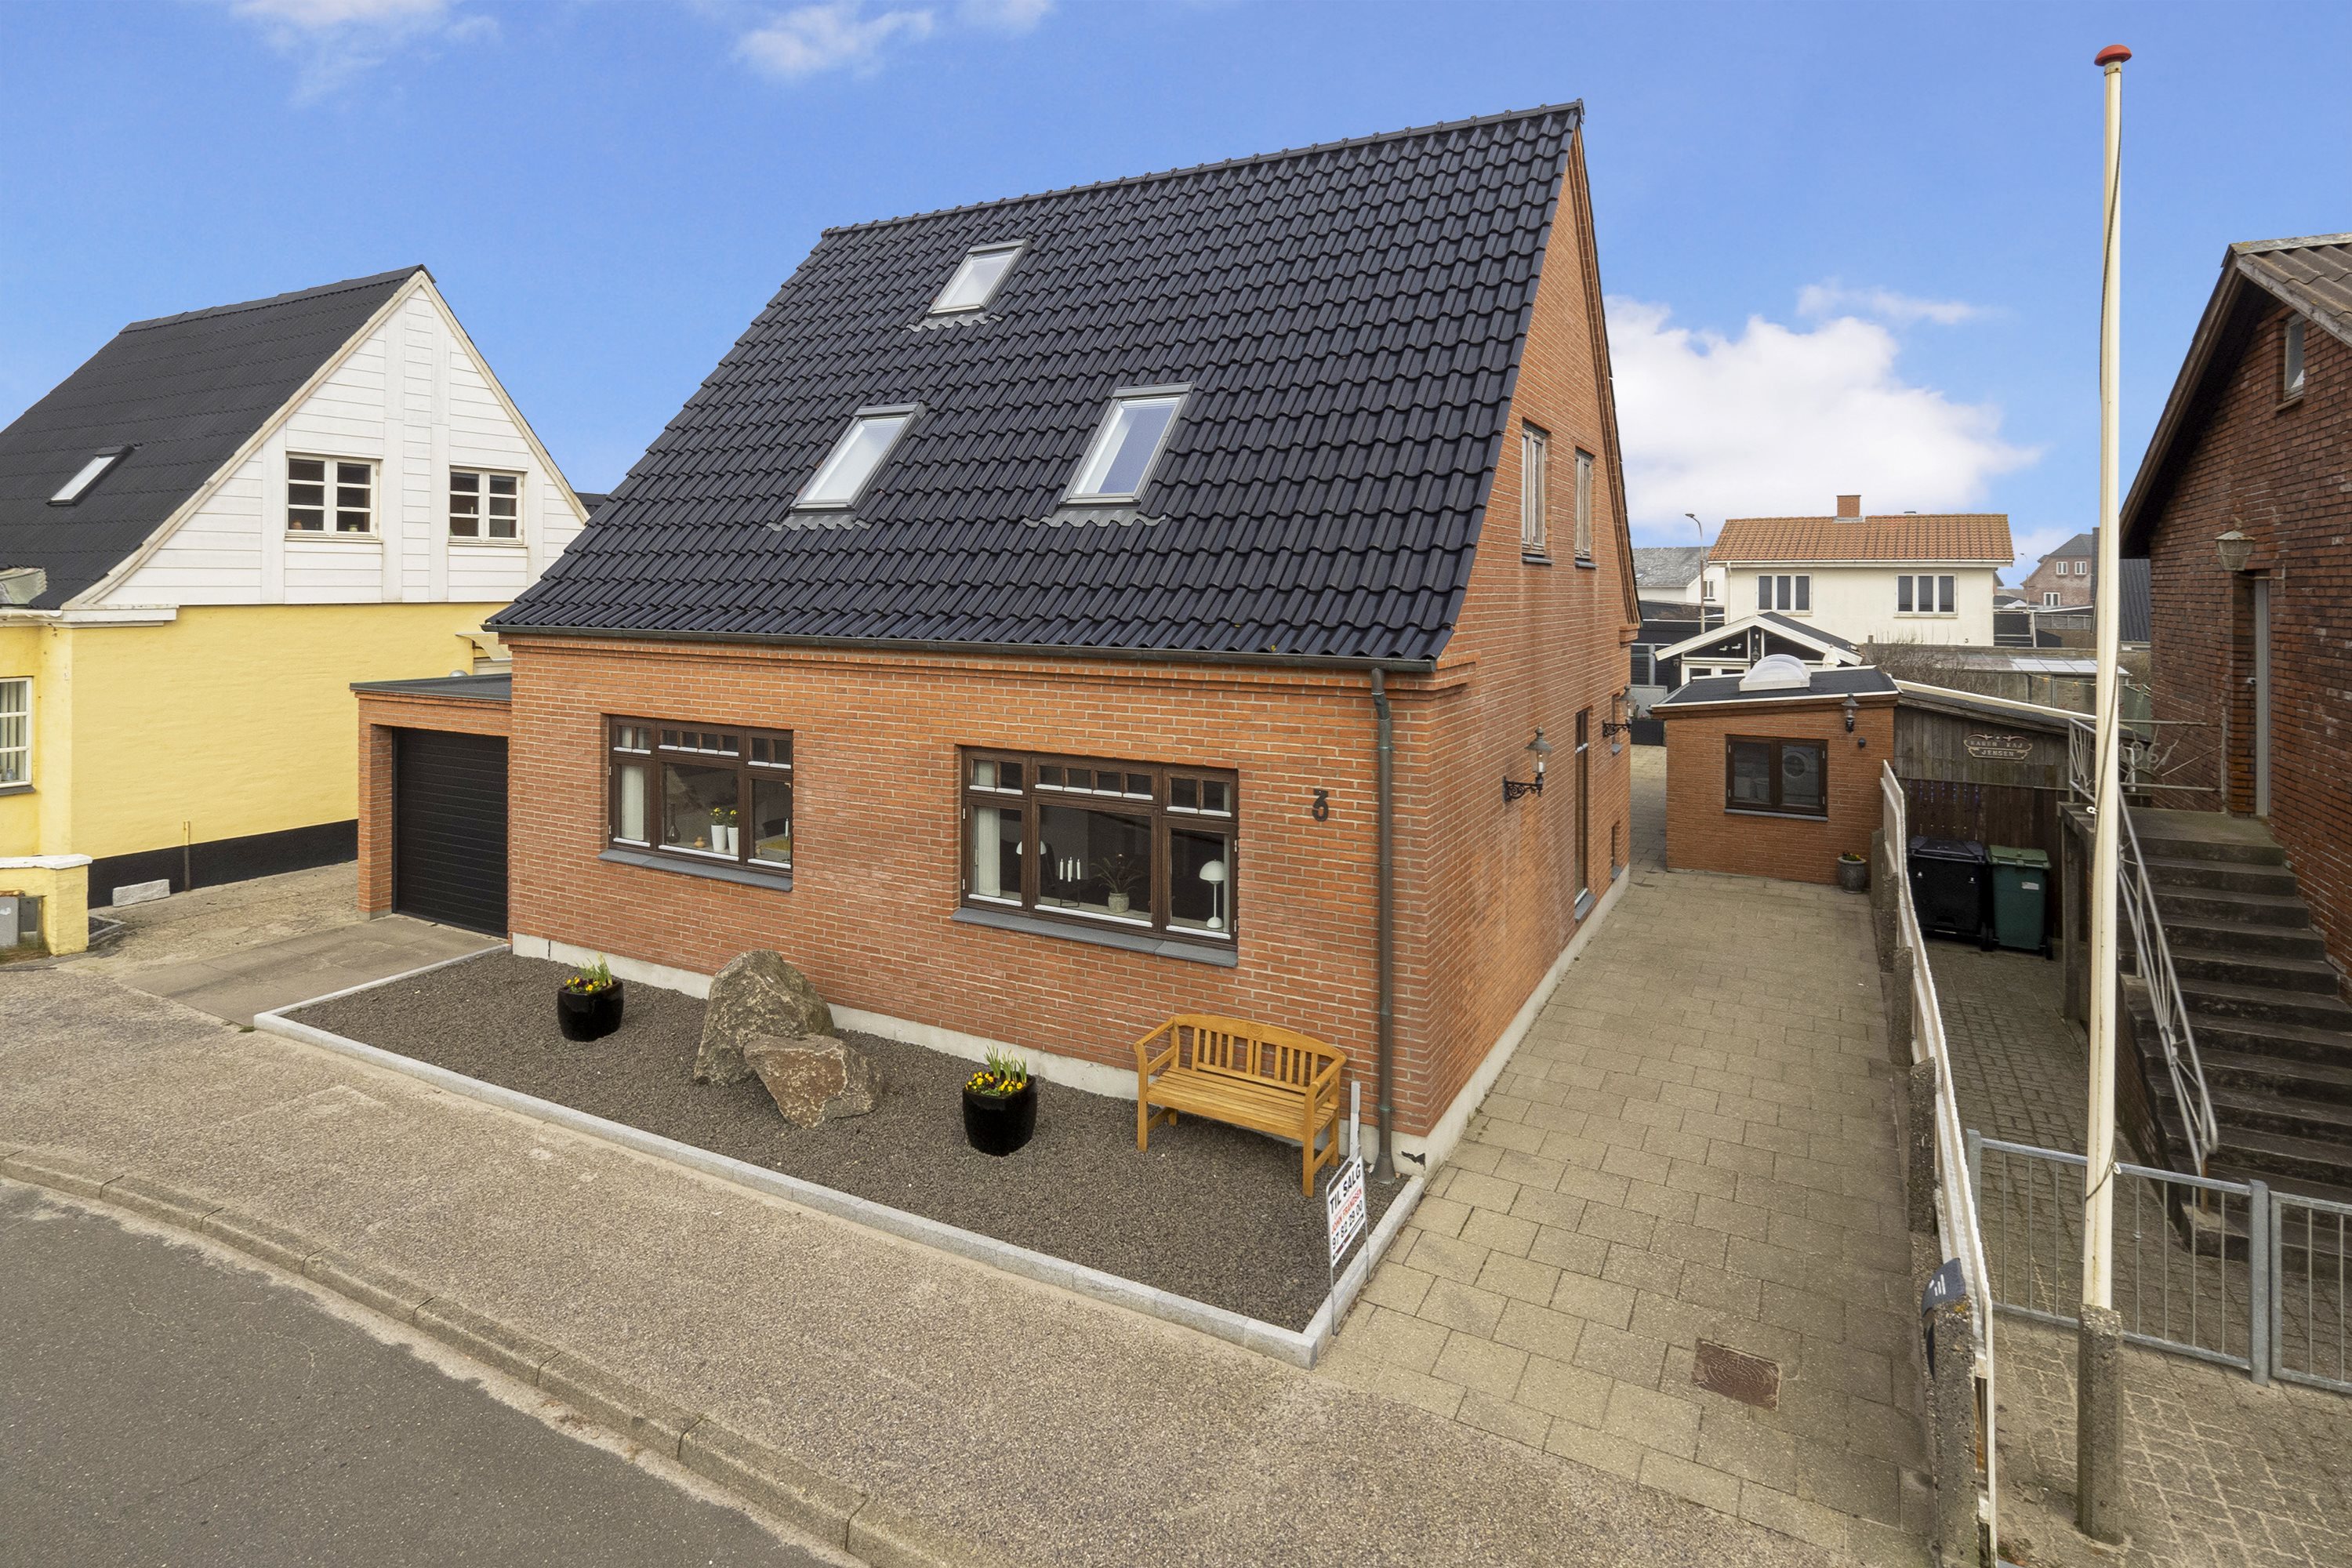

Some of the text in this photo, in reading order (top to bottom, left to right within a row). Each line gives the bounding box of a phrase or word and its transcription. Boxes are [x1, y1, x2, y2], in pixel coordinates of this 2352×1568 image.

[1312, 788, 1329, 822] 6
[1330, 1163, 1361, 1214] TIL SALG
[1332, 1232, 1339, 1250] 97
[1341, 1221, 1348, 1239] 82
[1356, 1200, 1363, 1216] 00
